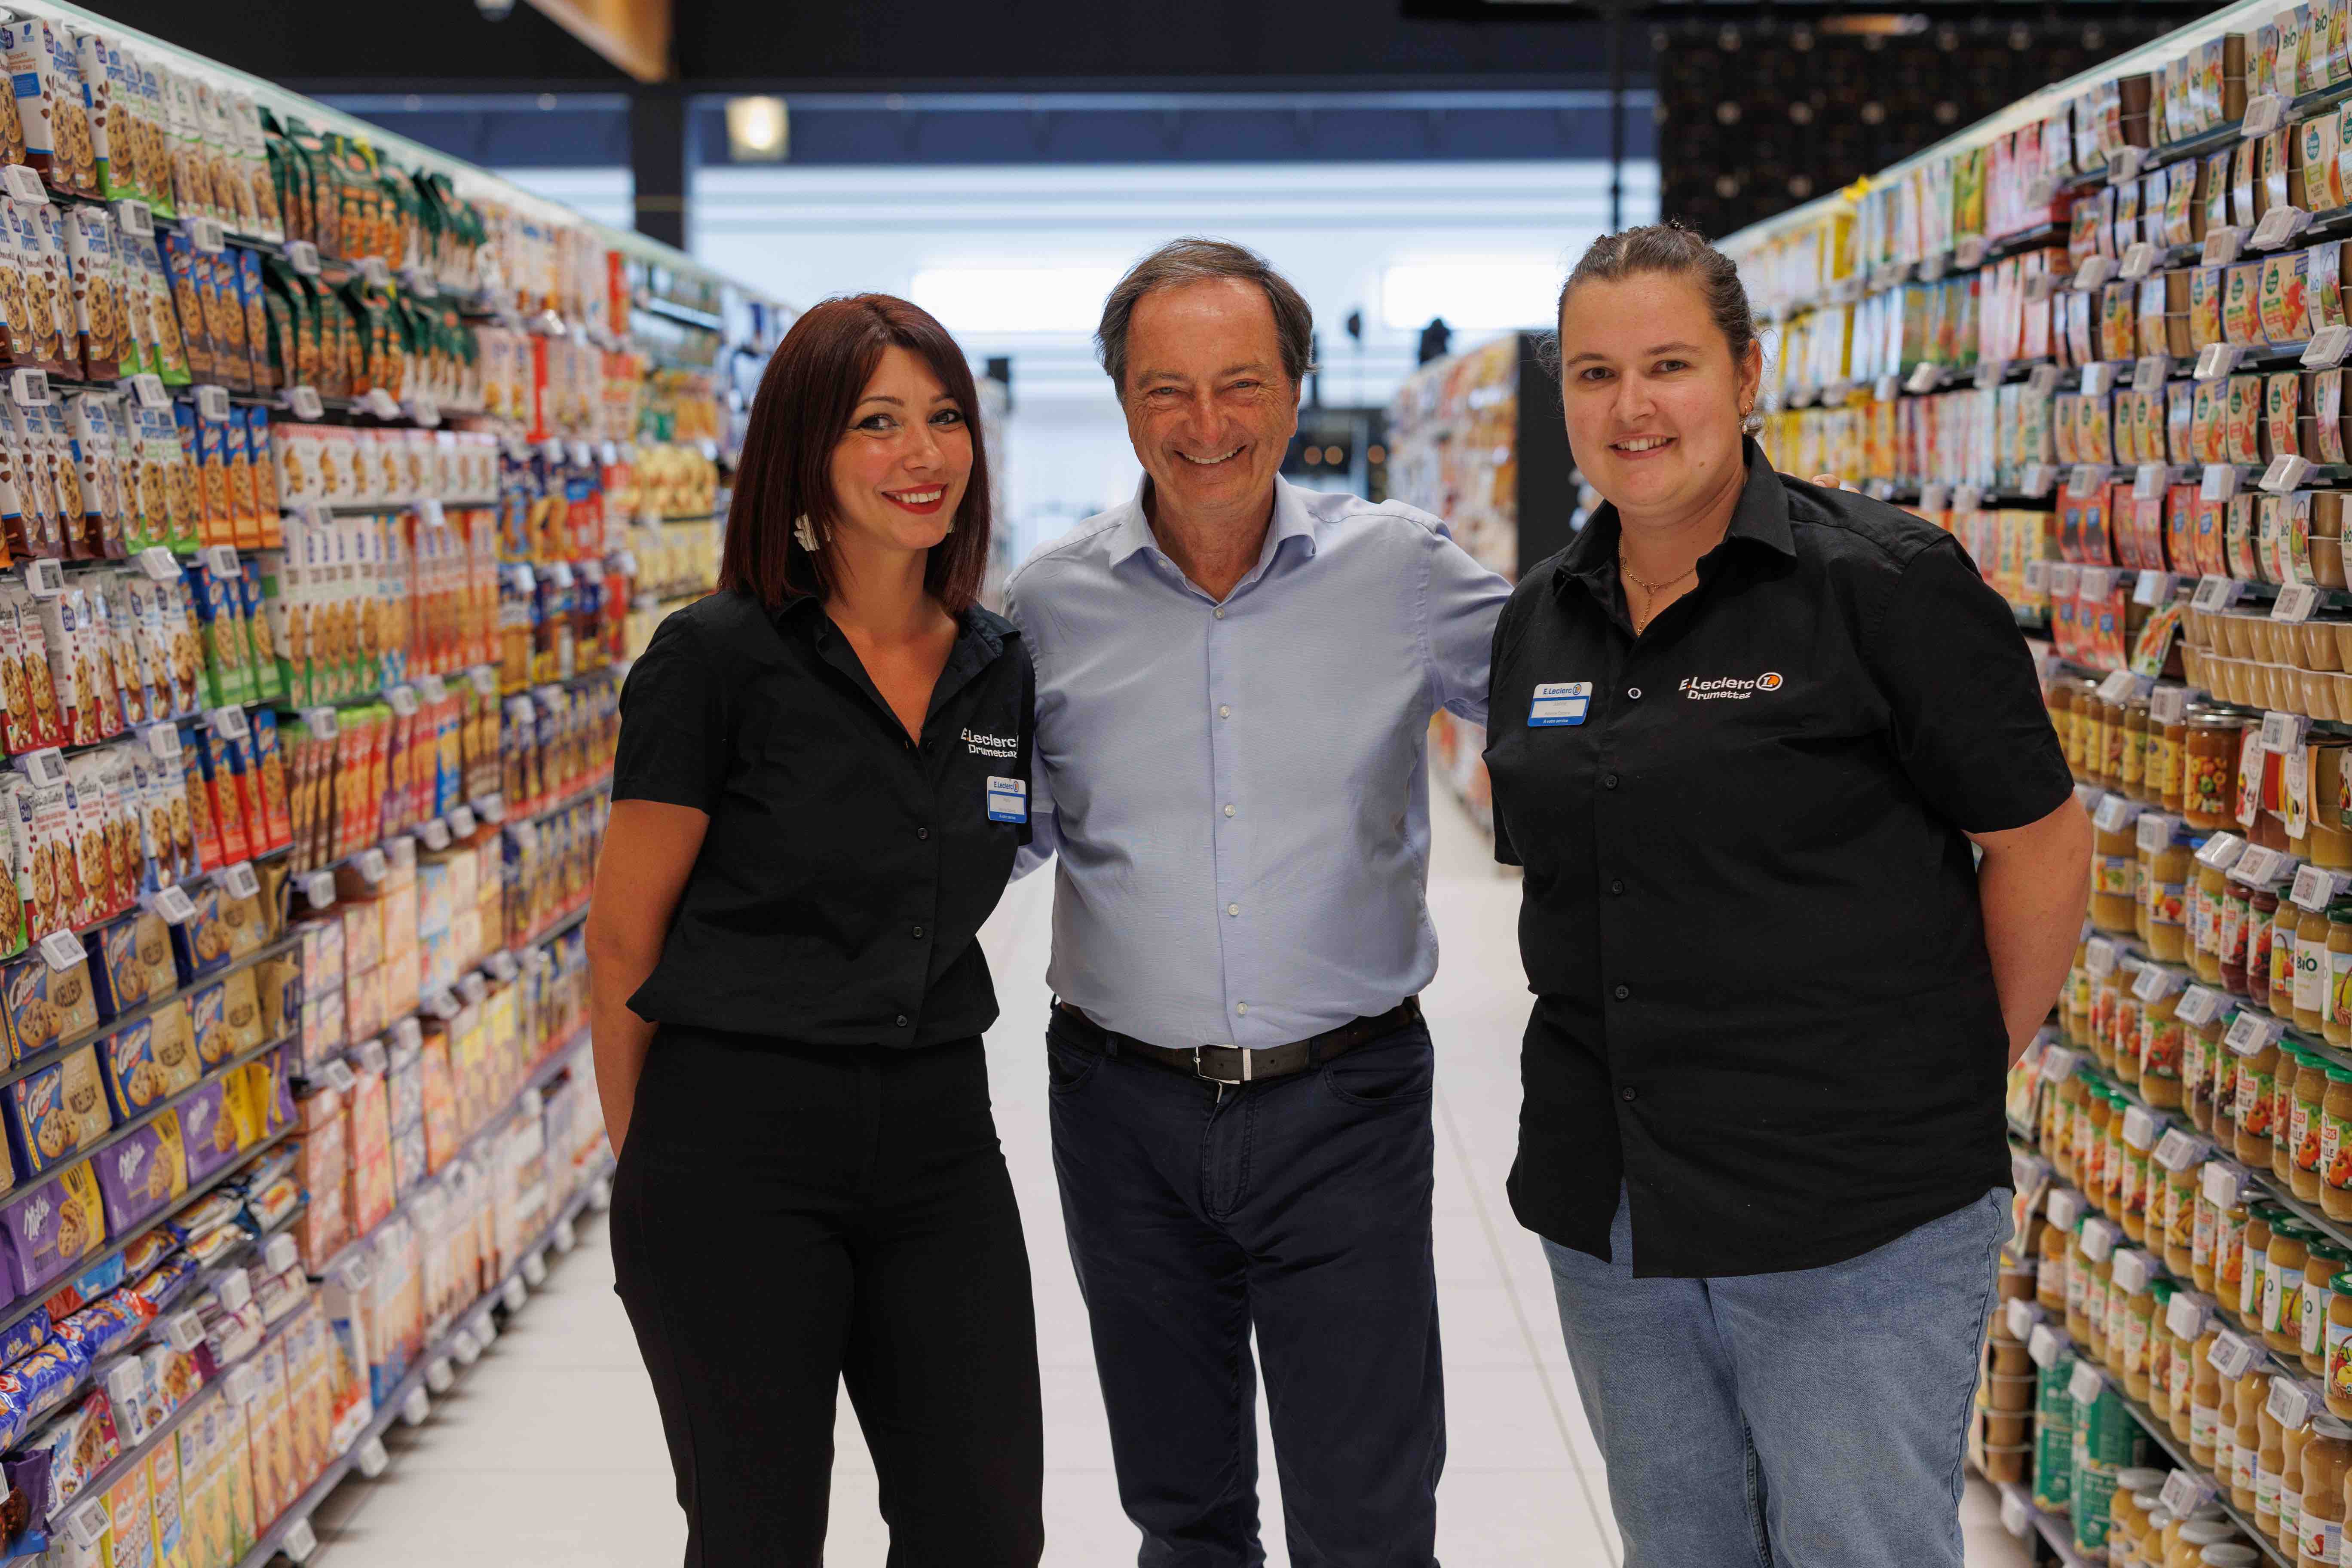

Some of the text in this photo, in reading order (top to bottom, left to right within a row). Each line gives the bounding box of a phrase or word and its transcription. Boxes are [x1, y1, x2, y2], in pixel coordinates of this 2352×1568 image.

[1678, 677, 1755, 691] E.Leclerc
[1687, 690, 1752, 700] Drumettaz
[960, 727, 1017, 747] E.Leclerc
